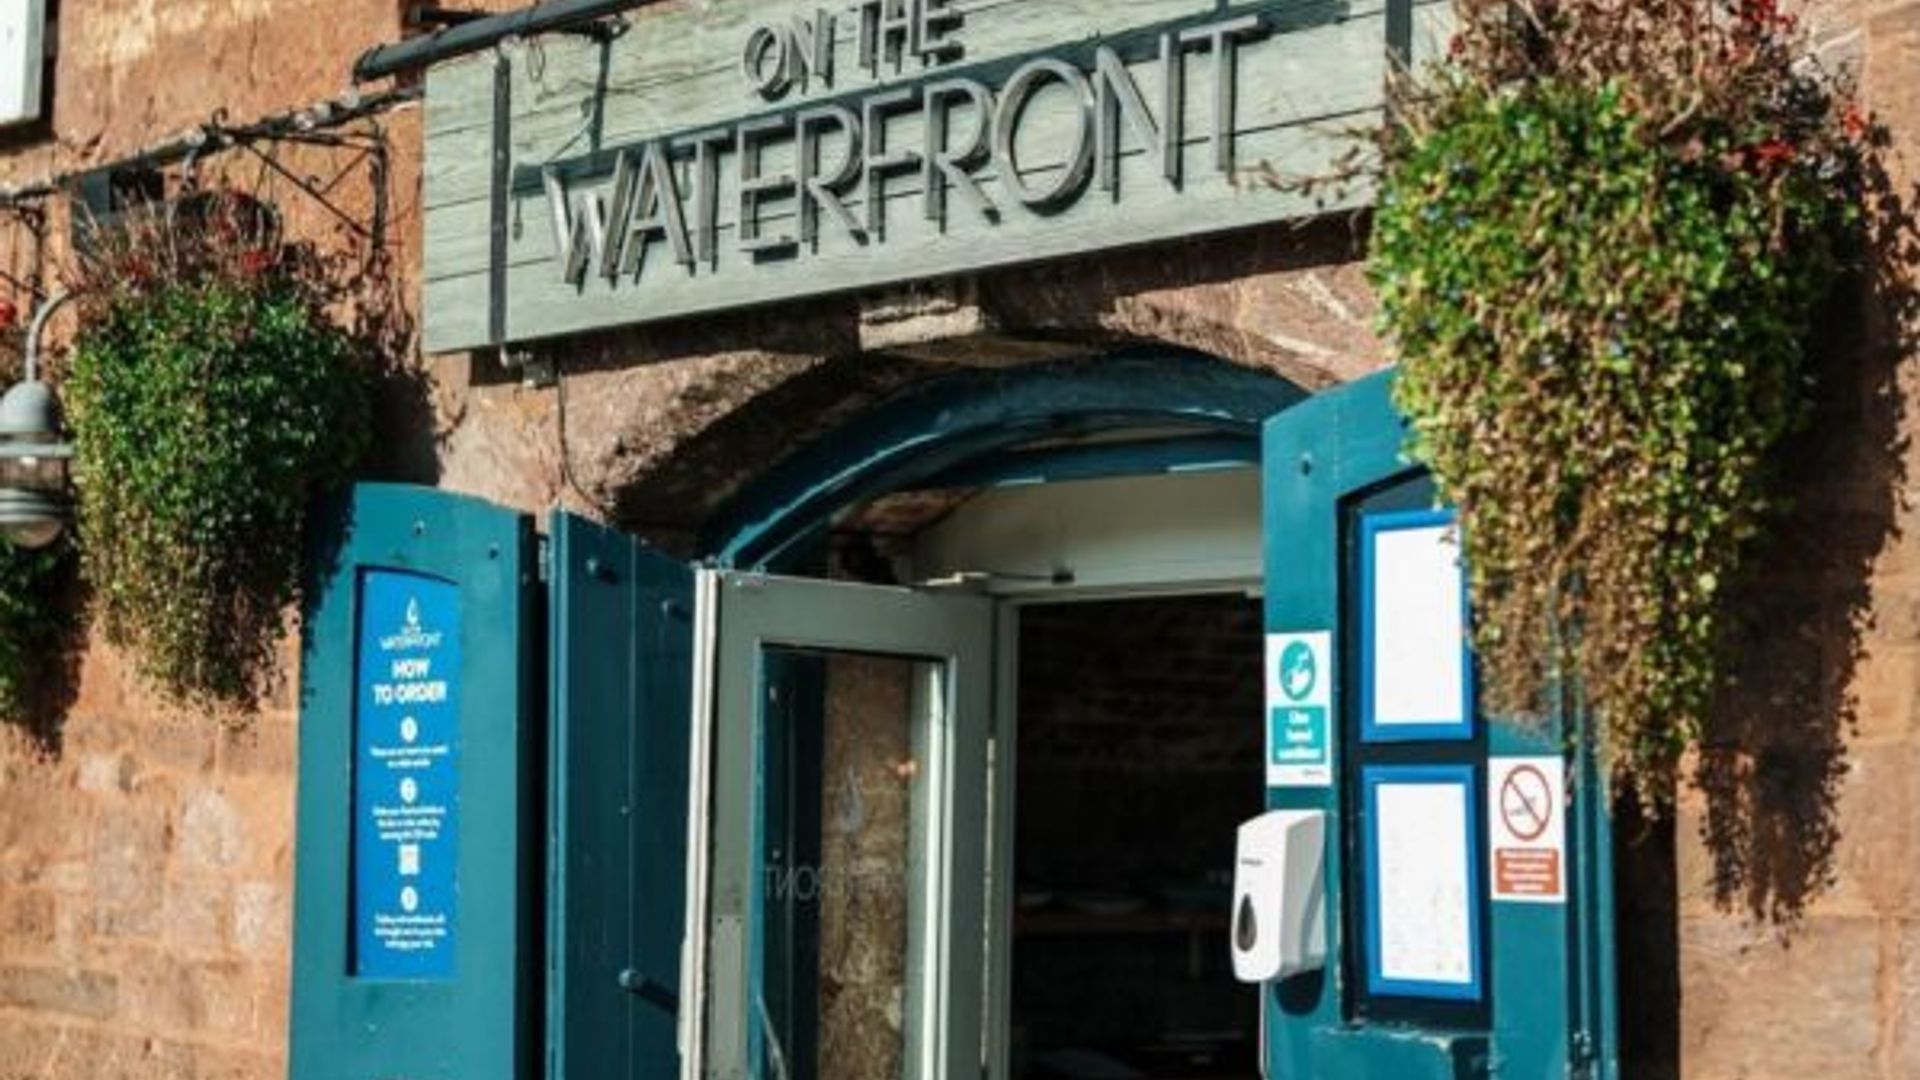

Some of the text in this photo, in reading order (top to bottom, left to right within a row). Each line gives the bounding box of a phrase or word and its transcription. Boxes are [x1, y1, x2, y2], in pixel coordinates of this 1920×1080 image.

[744, 0, 963, 98] ON THE
[542, 14, 1260, 286] WATERFRONT
[373, 680, 447, 706] TO ORDER
[391, 659, 431, 679] HOW
